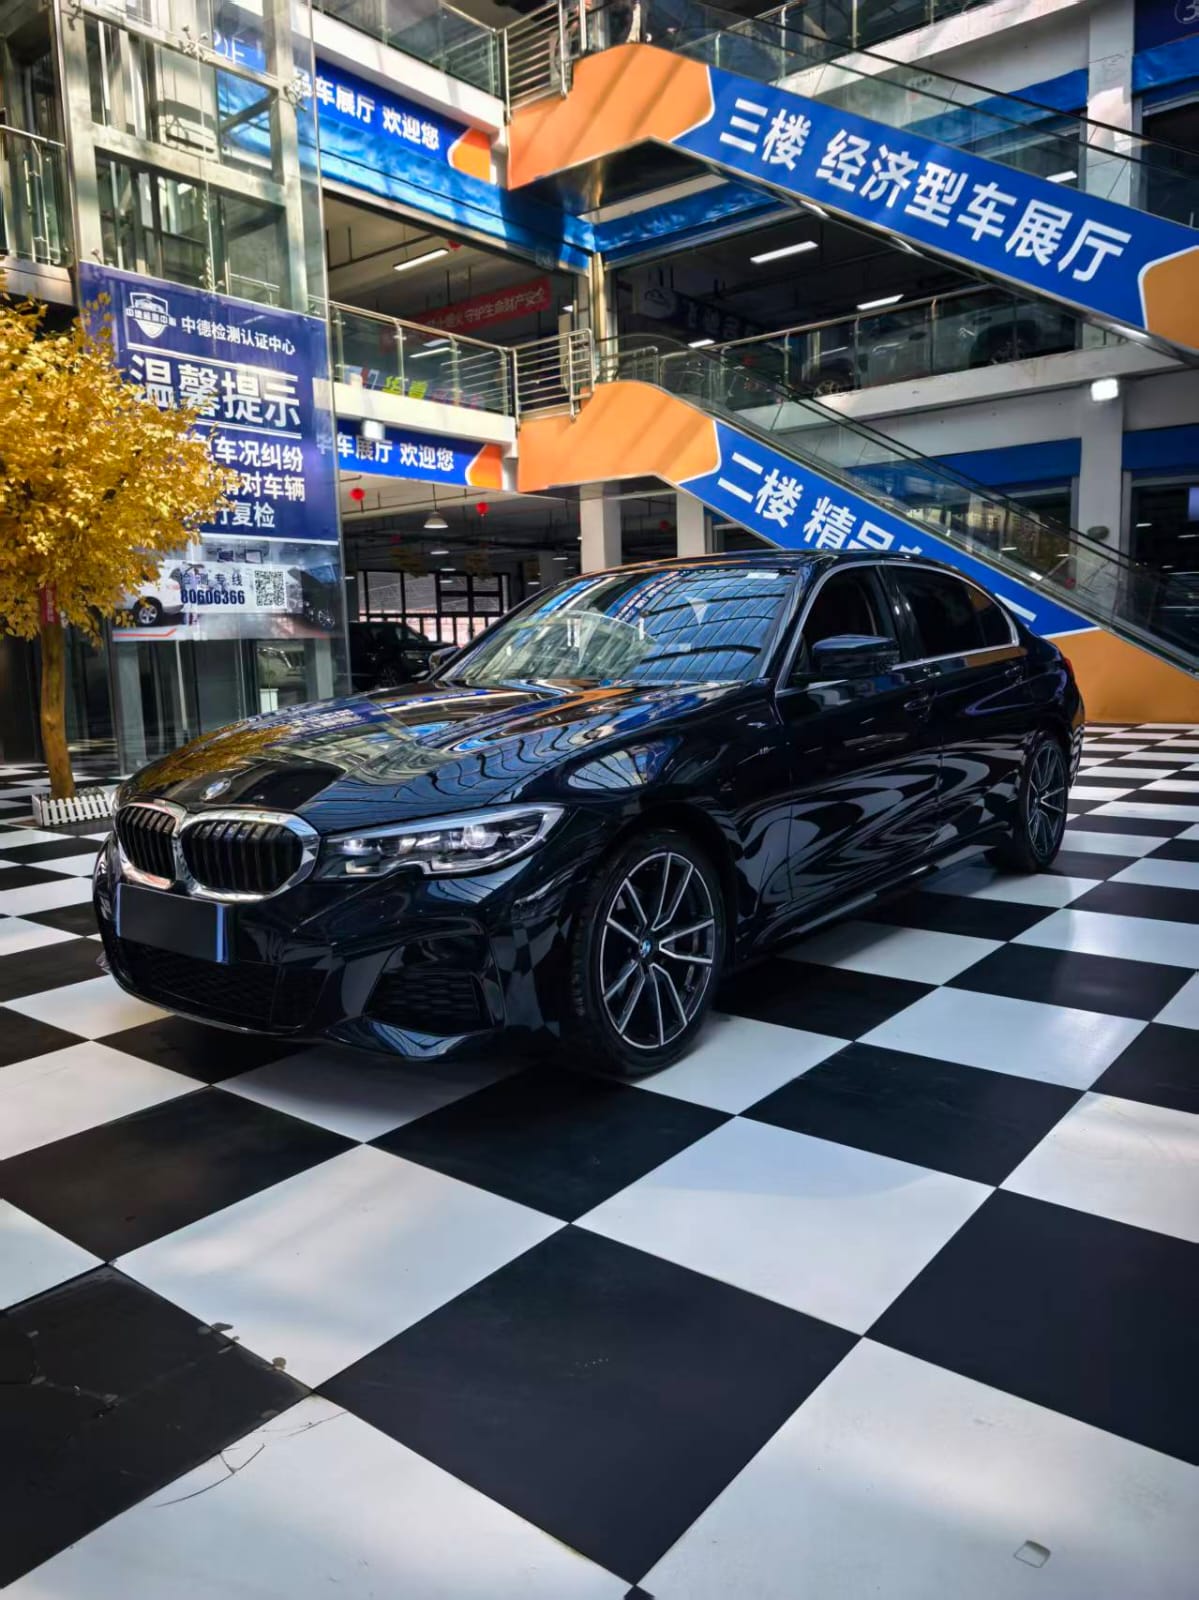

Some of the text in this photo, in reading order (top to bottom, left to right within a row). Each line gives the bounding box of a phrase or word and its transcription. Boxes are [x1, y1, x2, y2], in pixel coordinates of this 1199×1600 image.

[382, 105, 440, 151] 欢迎您
[719, 98, 1132, 283] 三楼 经济型车展厅
[181, 315, 296, 356] 中德检测认证中心
[129, 354, 301, 428] 温馨提示
[400, 442, 455, 472] 欢迎您
[717, 452, 923, 554] 二楼 精品
[180, 589, 246, 605] 80606366
